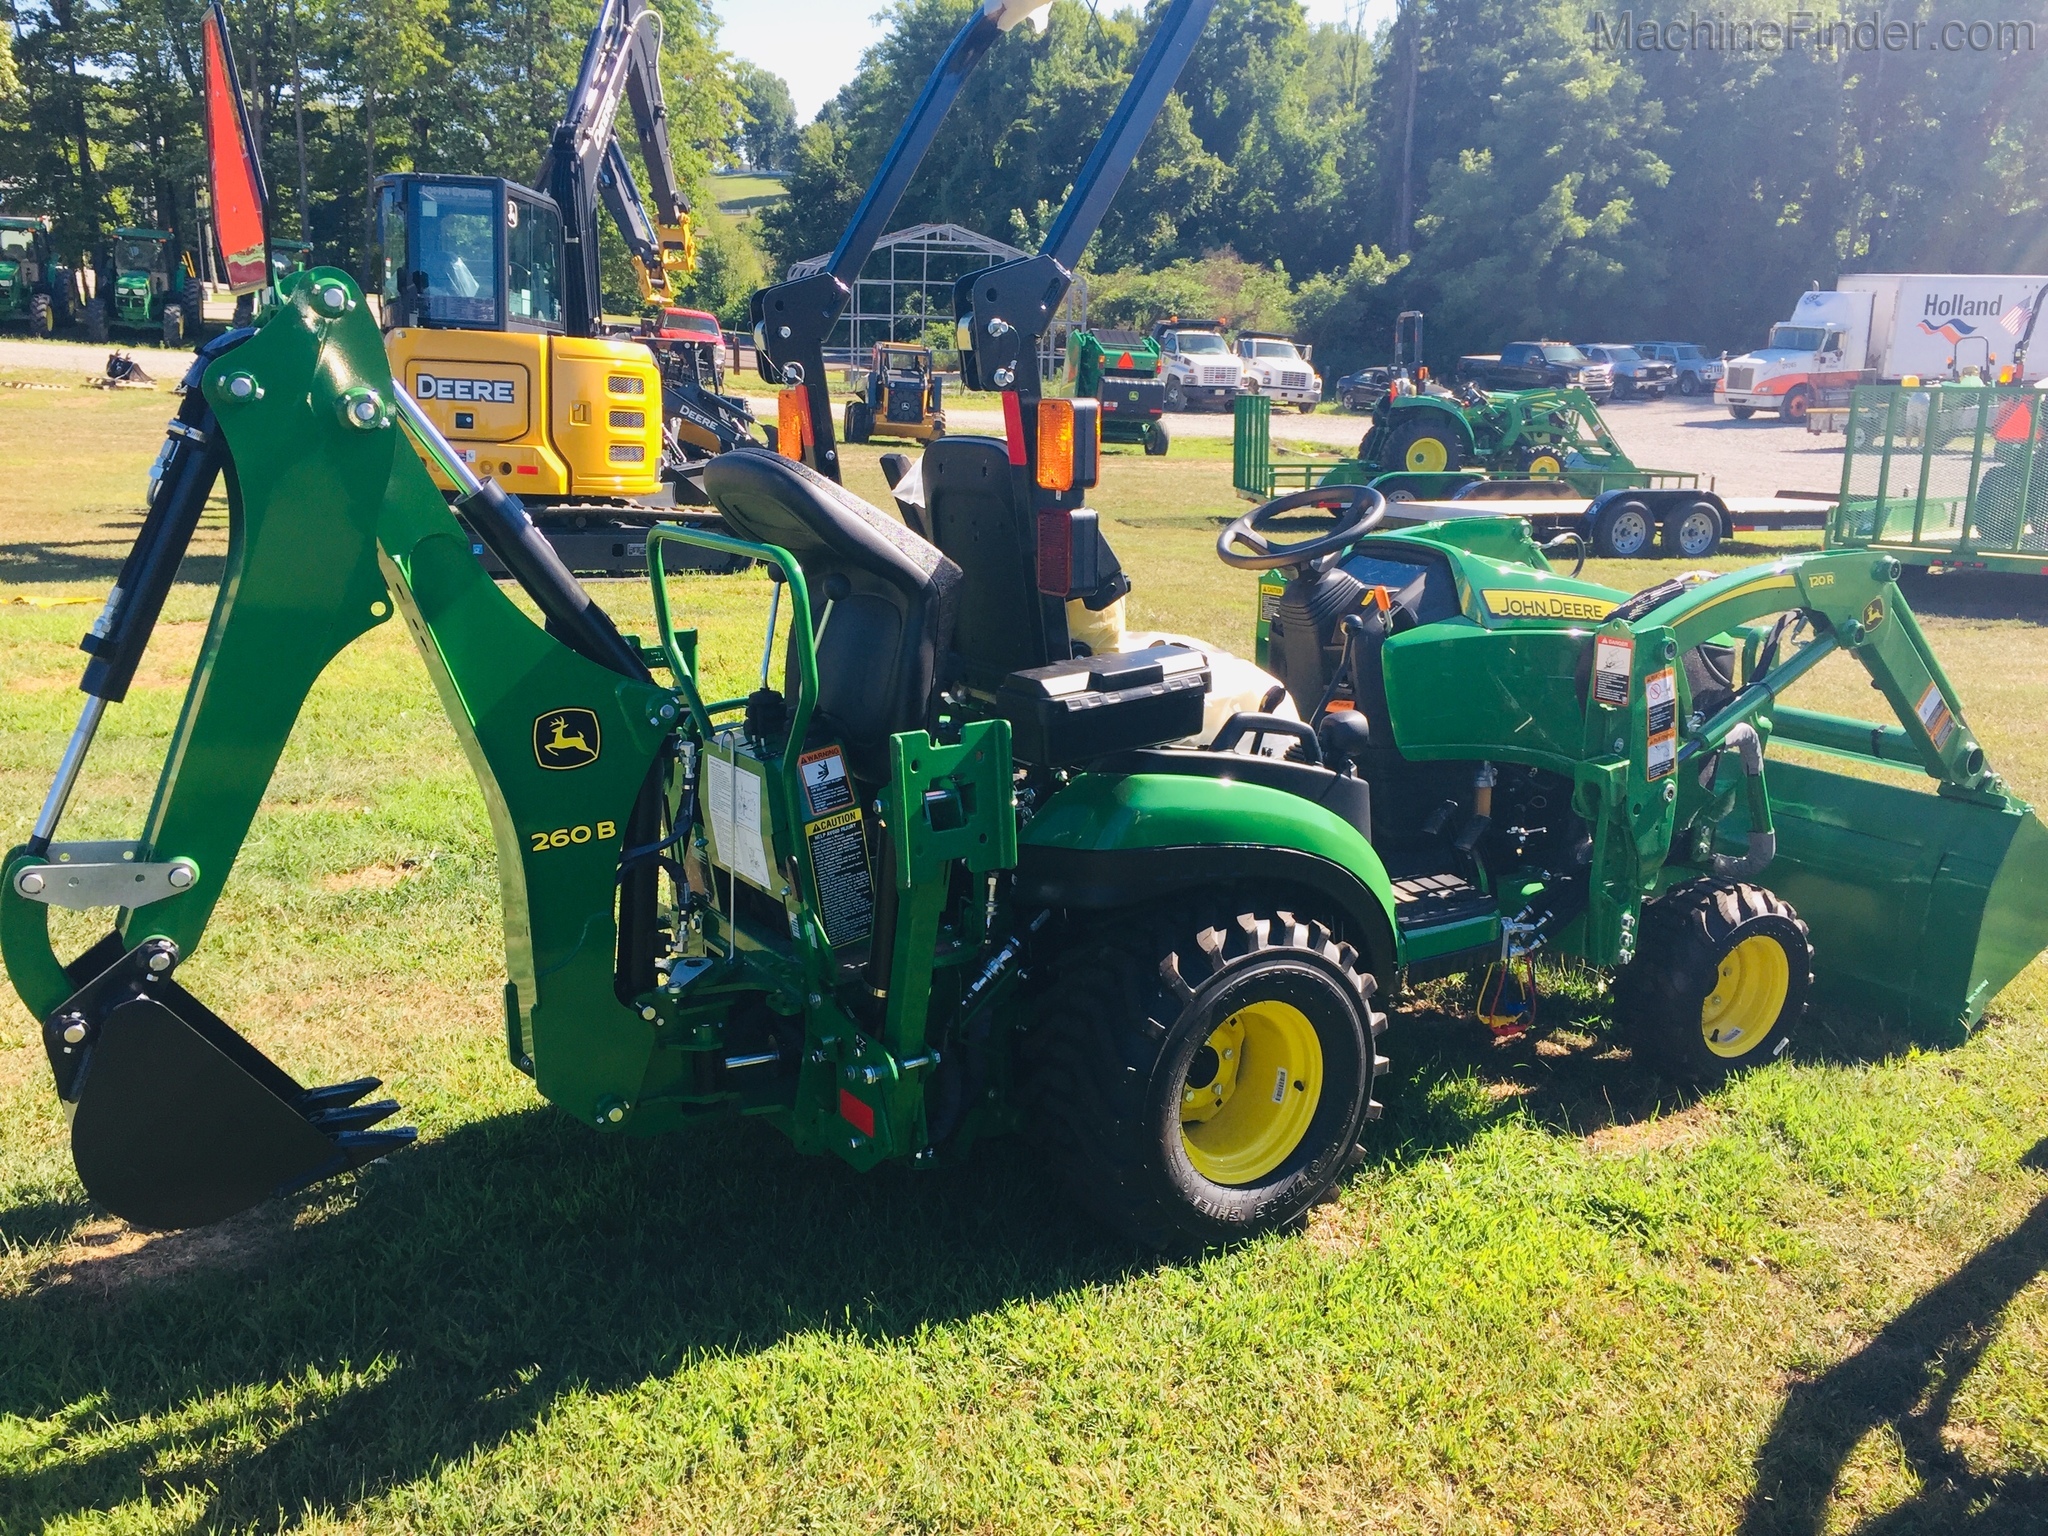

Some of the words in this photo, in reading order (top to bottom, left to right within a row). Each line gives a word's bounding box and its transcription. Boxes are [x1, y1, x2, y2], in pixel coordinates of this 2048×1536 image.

[1924, 294, 2003, 316] Holland
[416, 374, 514, 403] DEERE
[680, 404, 718, 430] DEERE
[1501, 597, 1546, 614] JOHN
[1550, 599, 1603, 618] DEERE
[807, 748, 840, 762] WARNING
[820, 812, 856, 830] CAUTION
[531, 825, 592, 852] 260
[597, 821, 616, 840] B
[1189, 1194, 1243, 1222] CHIEF
